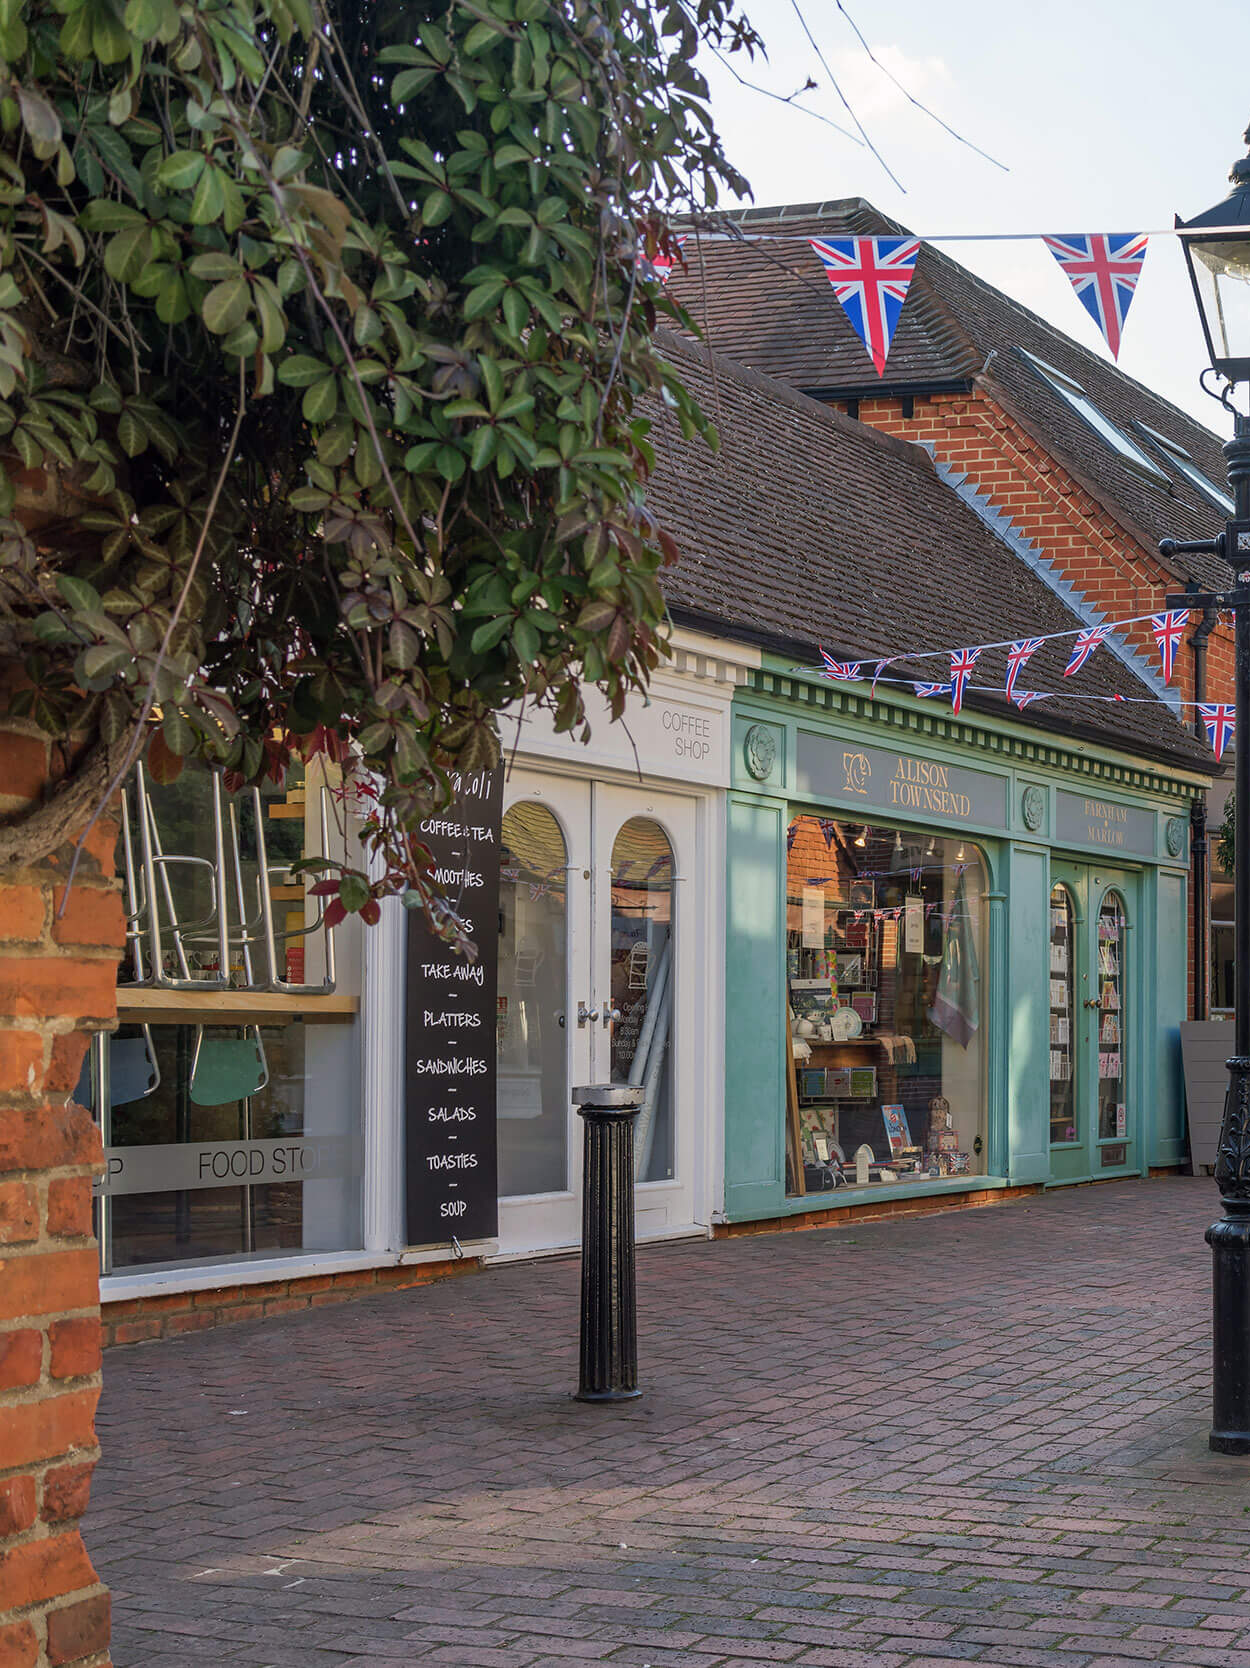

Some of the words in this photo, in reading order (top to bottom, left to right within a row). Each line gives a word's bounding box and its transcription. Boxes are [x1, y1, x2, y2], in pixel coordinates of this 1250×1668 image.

[662, 710, 711, 738] COFFEE
[674, 737, 710, 760] SHOP
[894, 758, 949, 789] ALISON
[889, 780, 971, 817] TOWNSEND
[420, 819, 462, 839] COFFEE
[471, 826, 495, 843] TEA
[421, 963, 451, 980] TAKE
[452, 963, 485, 986] AWAY
[423, 1010, 482, 1028] PLATTERS
[416, 1056, 488, 1076] SANDWICHES
[428, 1107, 477, 1123] SALADS
[199, 1149, 266, 1181] FOOD
[426, 1153, 479, 1171] TOASTIES
[440, 1200, 467, 1218] SOUP
